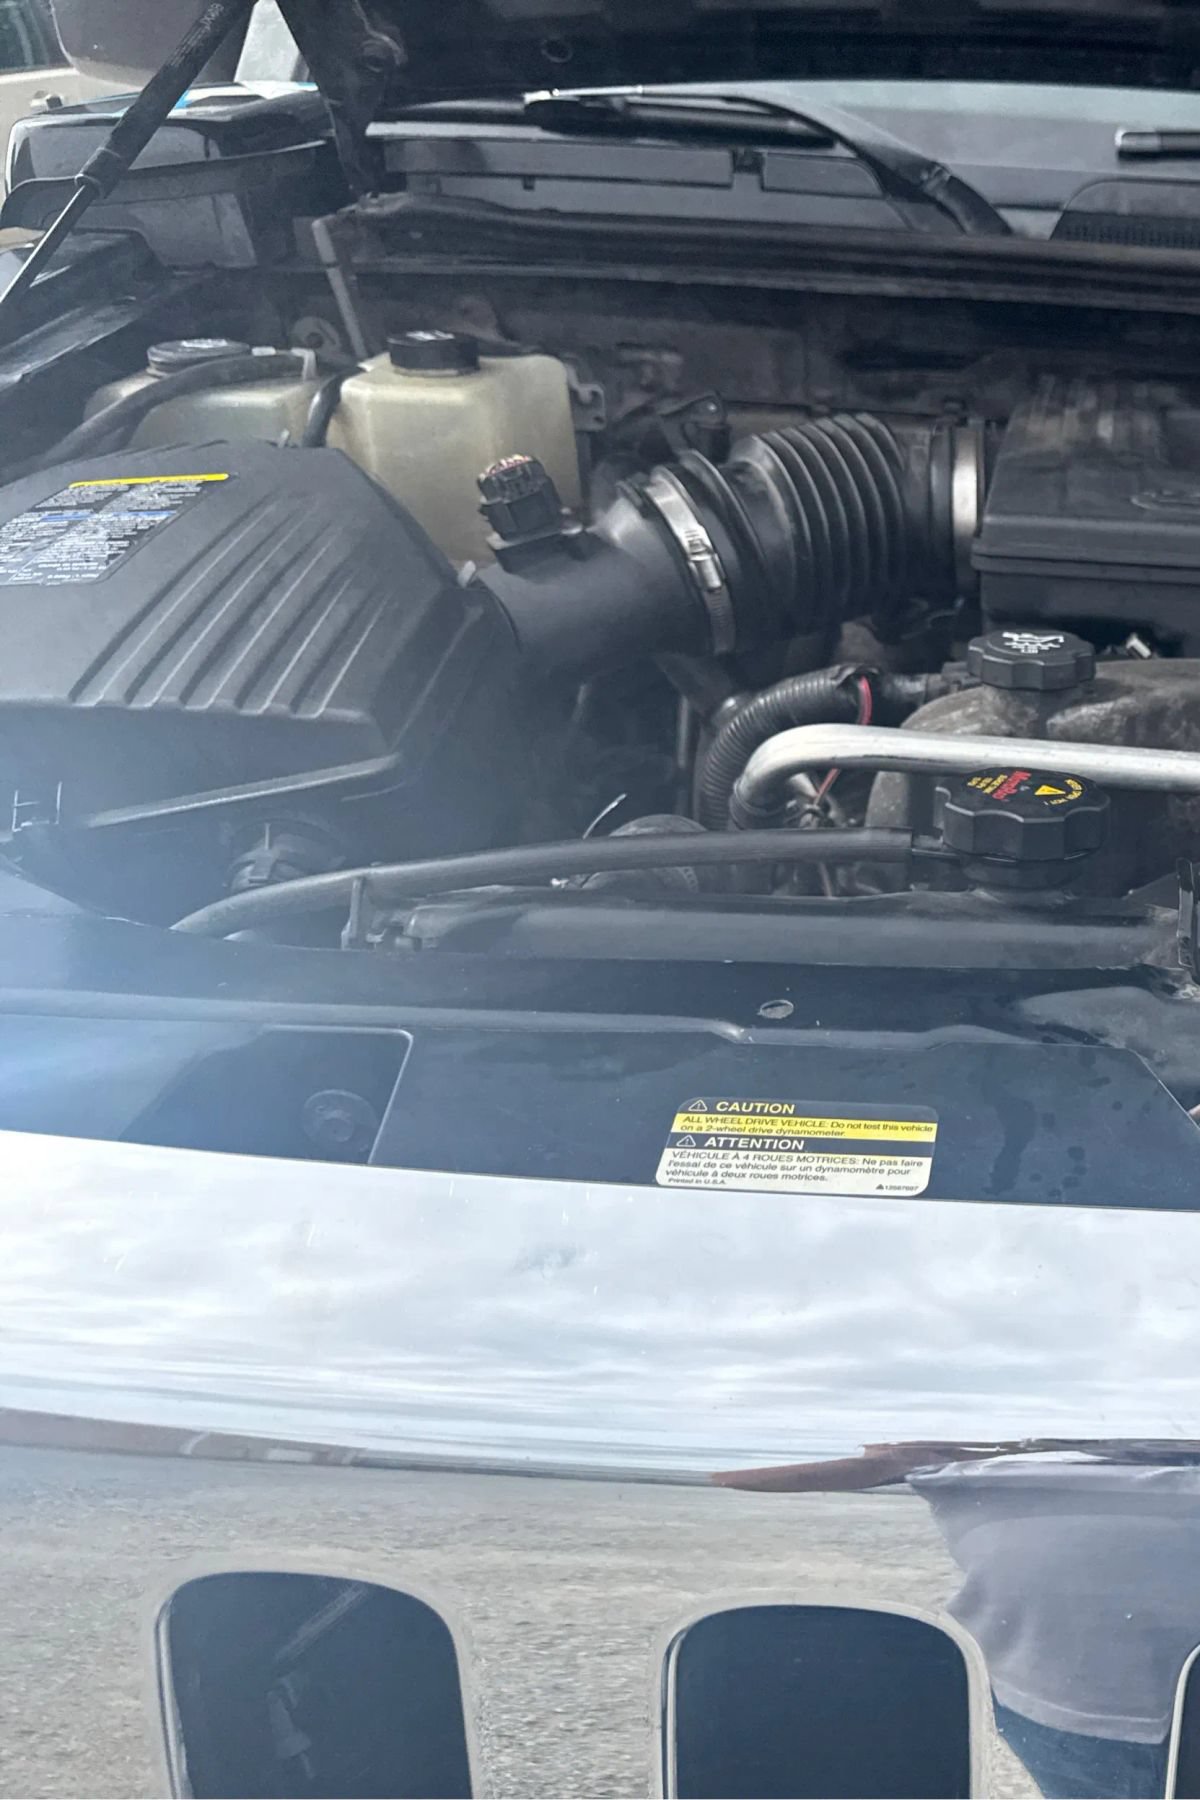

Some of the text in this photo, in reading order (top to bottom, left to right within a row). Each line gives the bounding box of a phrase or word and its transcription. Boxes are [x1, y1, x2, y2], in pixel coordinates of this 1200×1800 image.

[715, 1101, 795, 1114] CAUTION
[682, 1115, 702, 1123] ALL
[705, 1116, 742, 1124] WHEEL
[742, 1117, 778, 1126] DRIVE
[846, 1122, 861, 1130] not
[863, 1122, 881, 1130] test
[882, 1122, 899, 1131] this
[900, 1123, 933, 1132] vehicle
[705, 1124, 746, 1132] 2-wheel
[748, 1125, 776, 1133] drive
[778, 1126, 846, 1136] dynamometer.
[703, 1137, 805, 1151] ATTENTION
[671, 1150, 729, 1160] VÉHICULE
[731, 1151, 740, 1161] À
[743, 1153, 750, 1161] 4
[752, 1153, 794, 1162] ROUES
[879, 1159, 898, 1167] pas
[900, 1159, 923, 1167] faire
[665, 1168, 828, 1181] véhicule à deux roues motrices.
[667, 1160, 701, 1168] l'essai
[735, 1161, 778, 1170] véhicule
[815, 1165, 885, 1175] dynamomètre
[887, 1168, 911, 1176] pour
